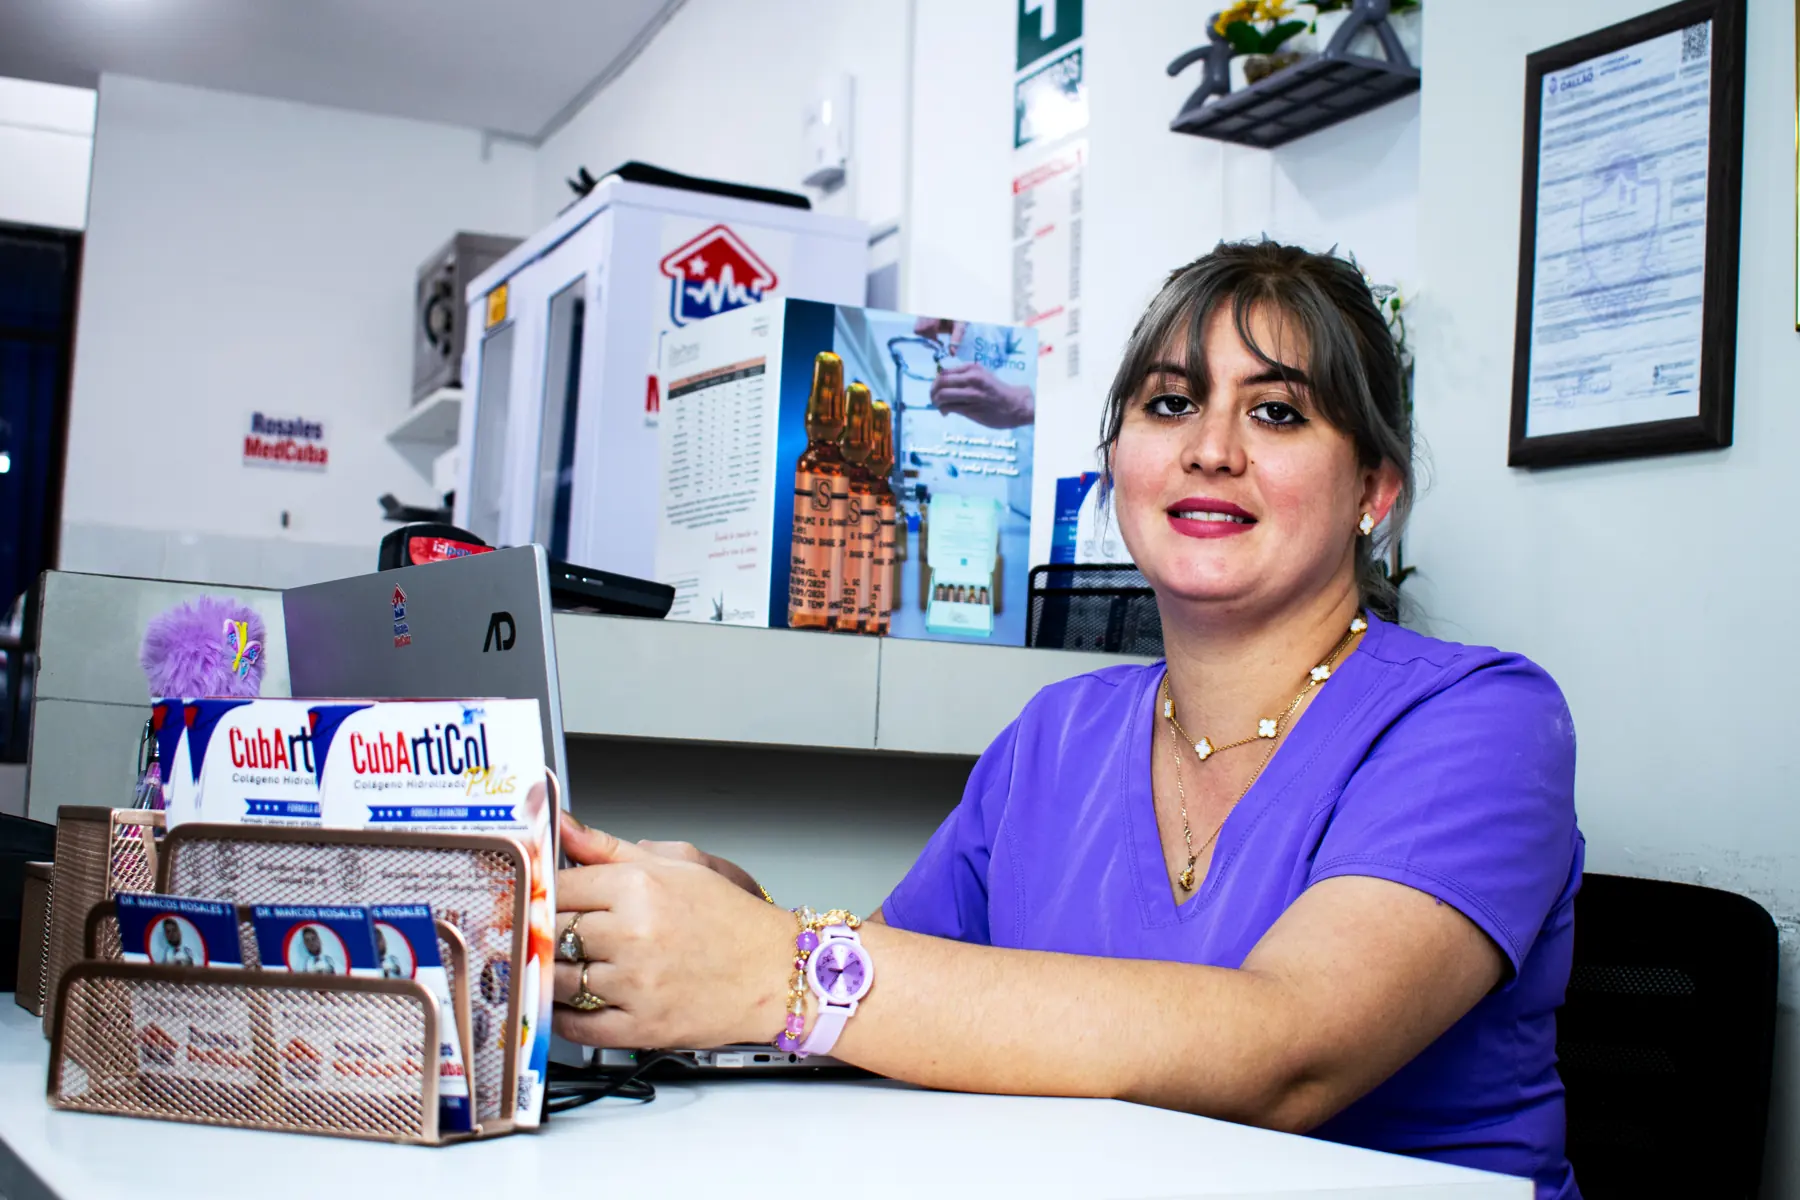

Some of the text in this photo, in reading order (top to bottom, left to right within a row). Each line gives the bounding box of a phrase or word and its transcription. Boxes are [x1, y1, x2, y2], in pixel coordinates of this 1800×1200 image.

[251, 410, 323, 440] Rosales
[244, 436, 328, 464] MedCuba
[350, 722, 490, 776] CubArtiCol
[137, 897, 178, 911] MARCOS
[180, 901, 222, 915] ROSALES
[274, 906, 317, 918] MARCOS
[319, 907, 365, 920] ROSALES
[382, 905, 428, 918] ROSALES
